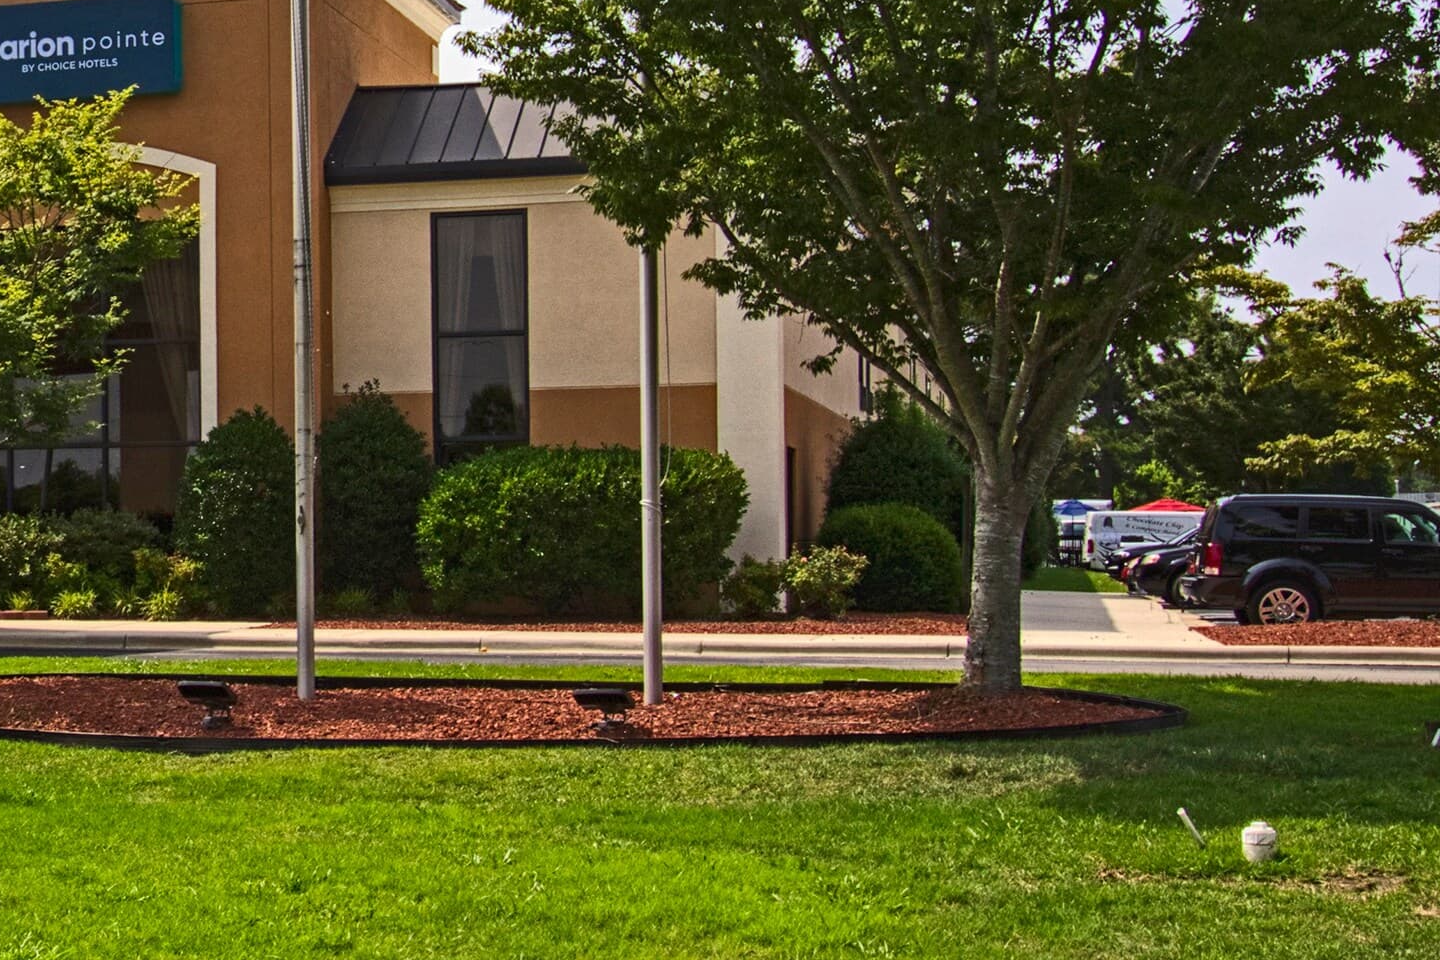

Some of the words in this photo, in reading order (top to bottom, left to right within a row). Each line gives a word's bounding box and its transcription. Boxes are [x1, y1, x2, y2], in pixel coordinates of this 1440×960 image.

[82, 30, 165, 55] pointe
[21, 63, 35, 73] BY
[37, 60, 76, 72] CHOICE
[78, 57, 118, 69] HOTELS
